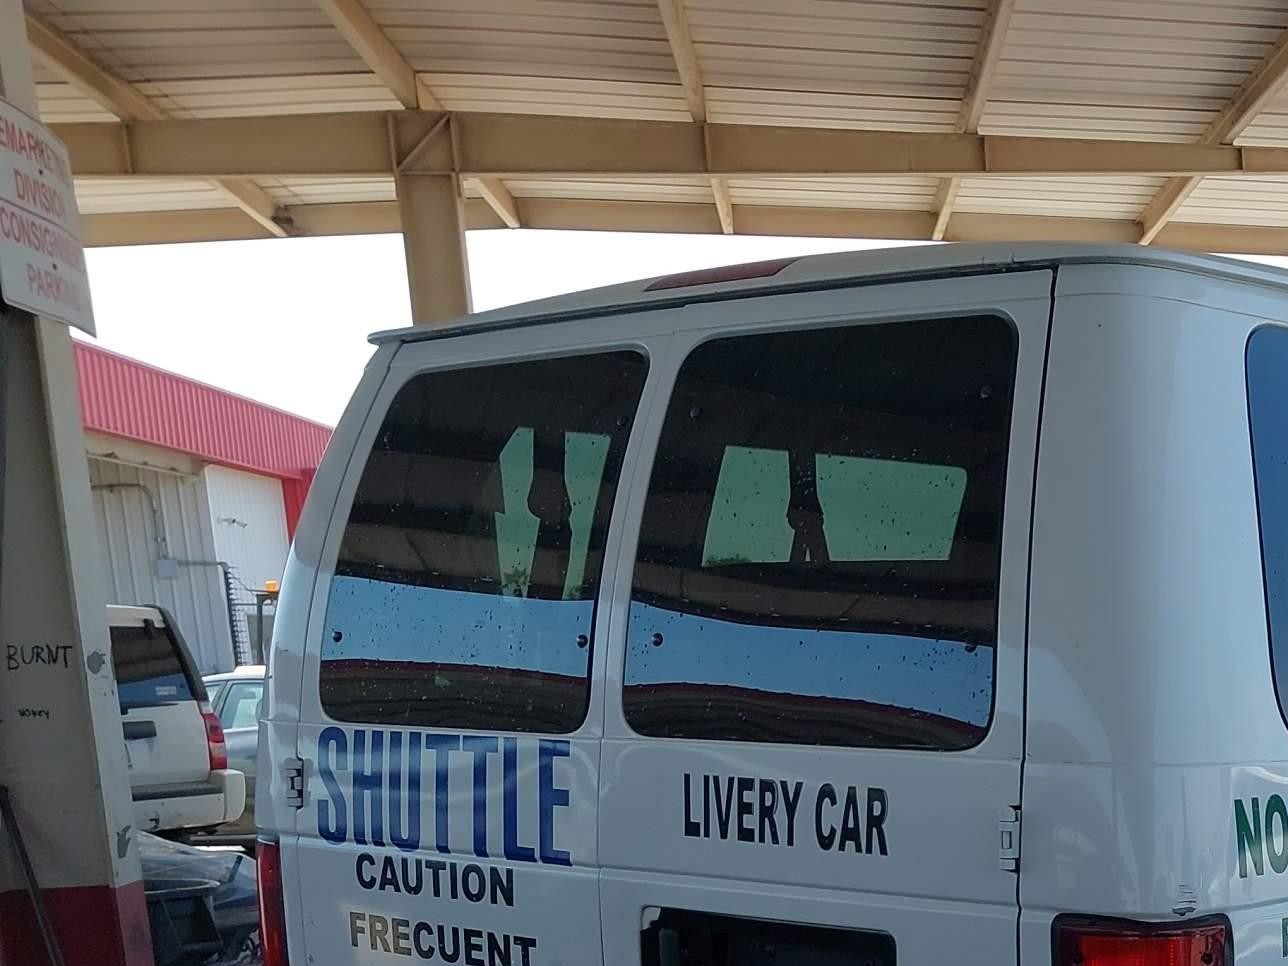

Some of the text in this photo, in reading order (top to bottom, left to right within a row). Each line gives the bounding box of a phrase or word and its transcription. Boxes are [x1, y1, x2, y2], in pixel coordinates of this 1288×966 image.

[7, 645, 73, 670] BURNT
[317, 726, 573, 867] SHUTTLE
[682, 772, 889, 856] LIVERY CAR
[355, 852, 514, 907] CAUTION
